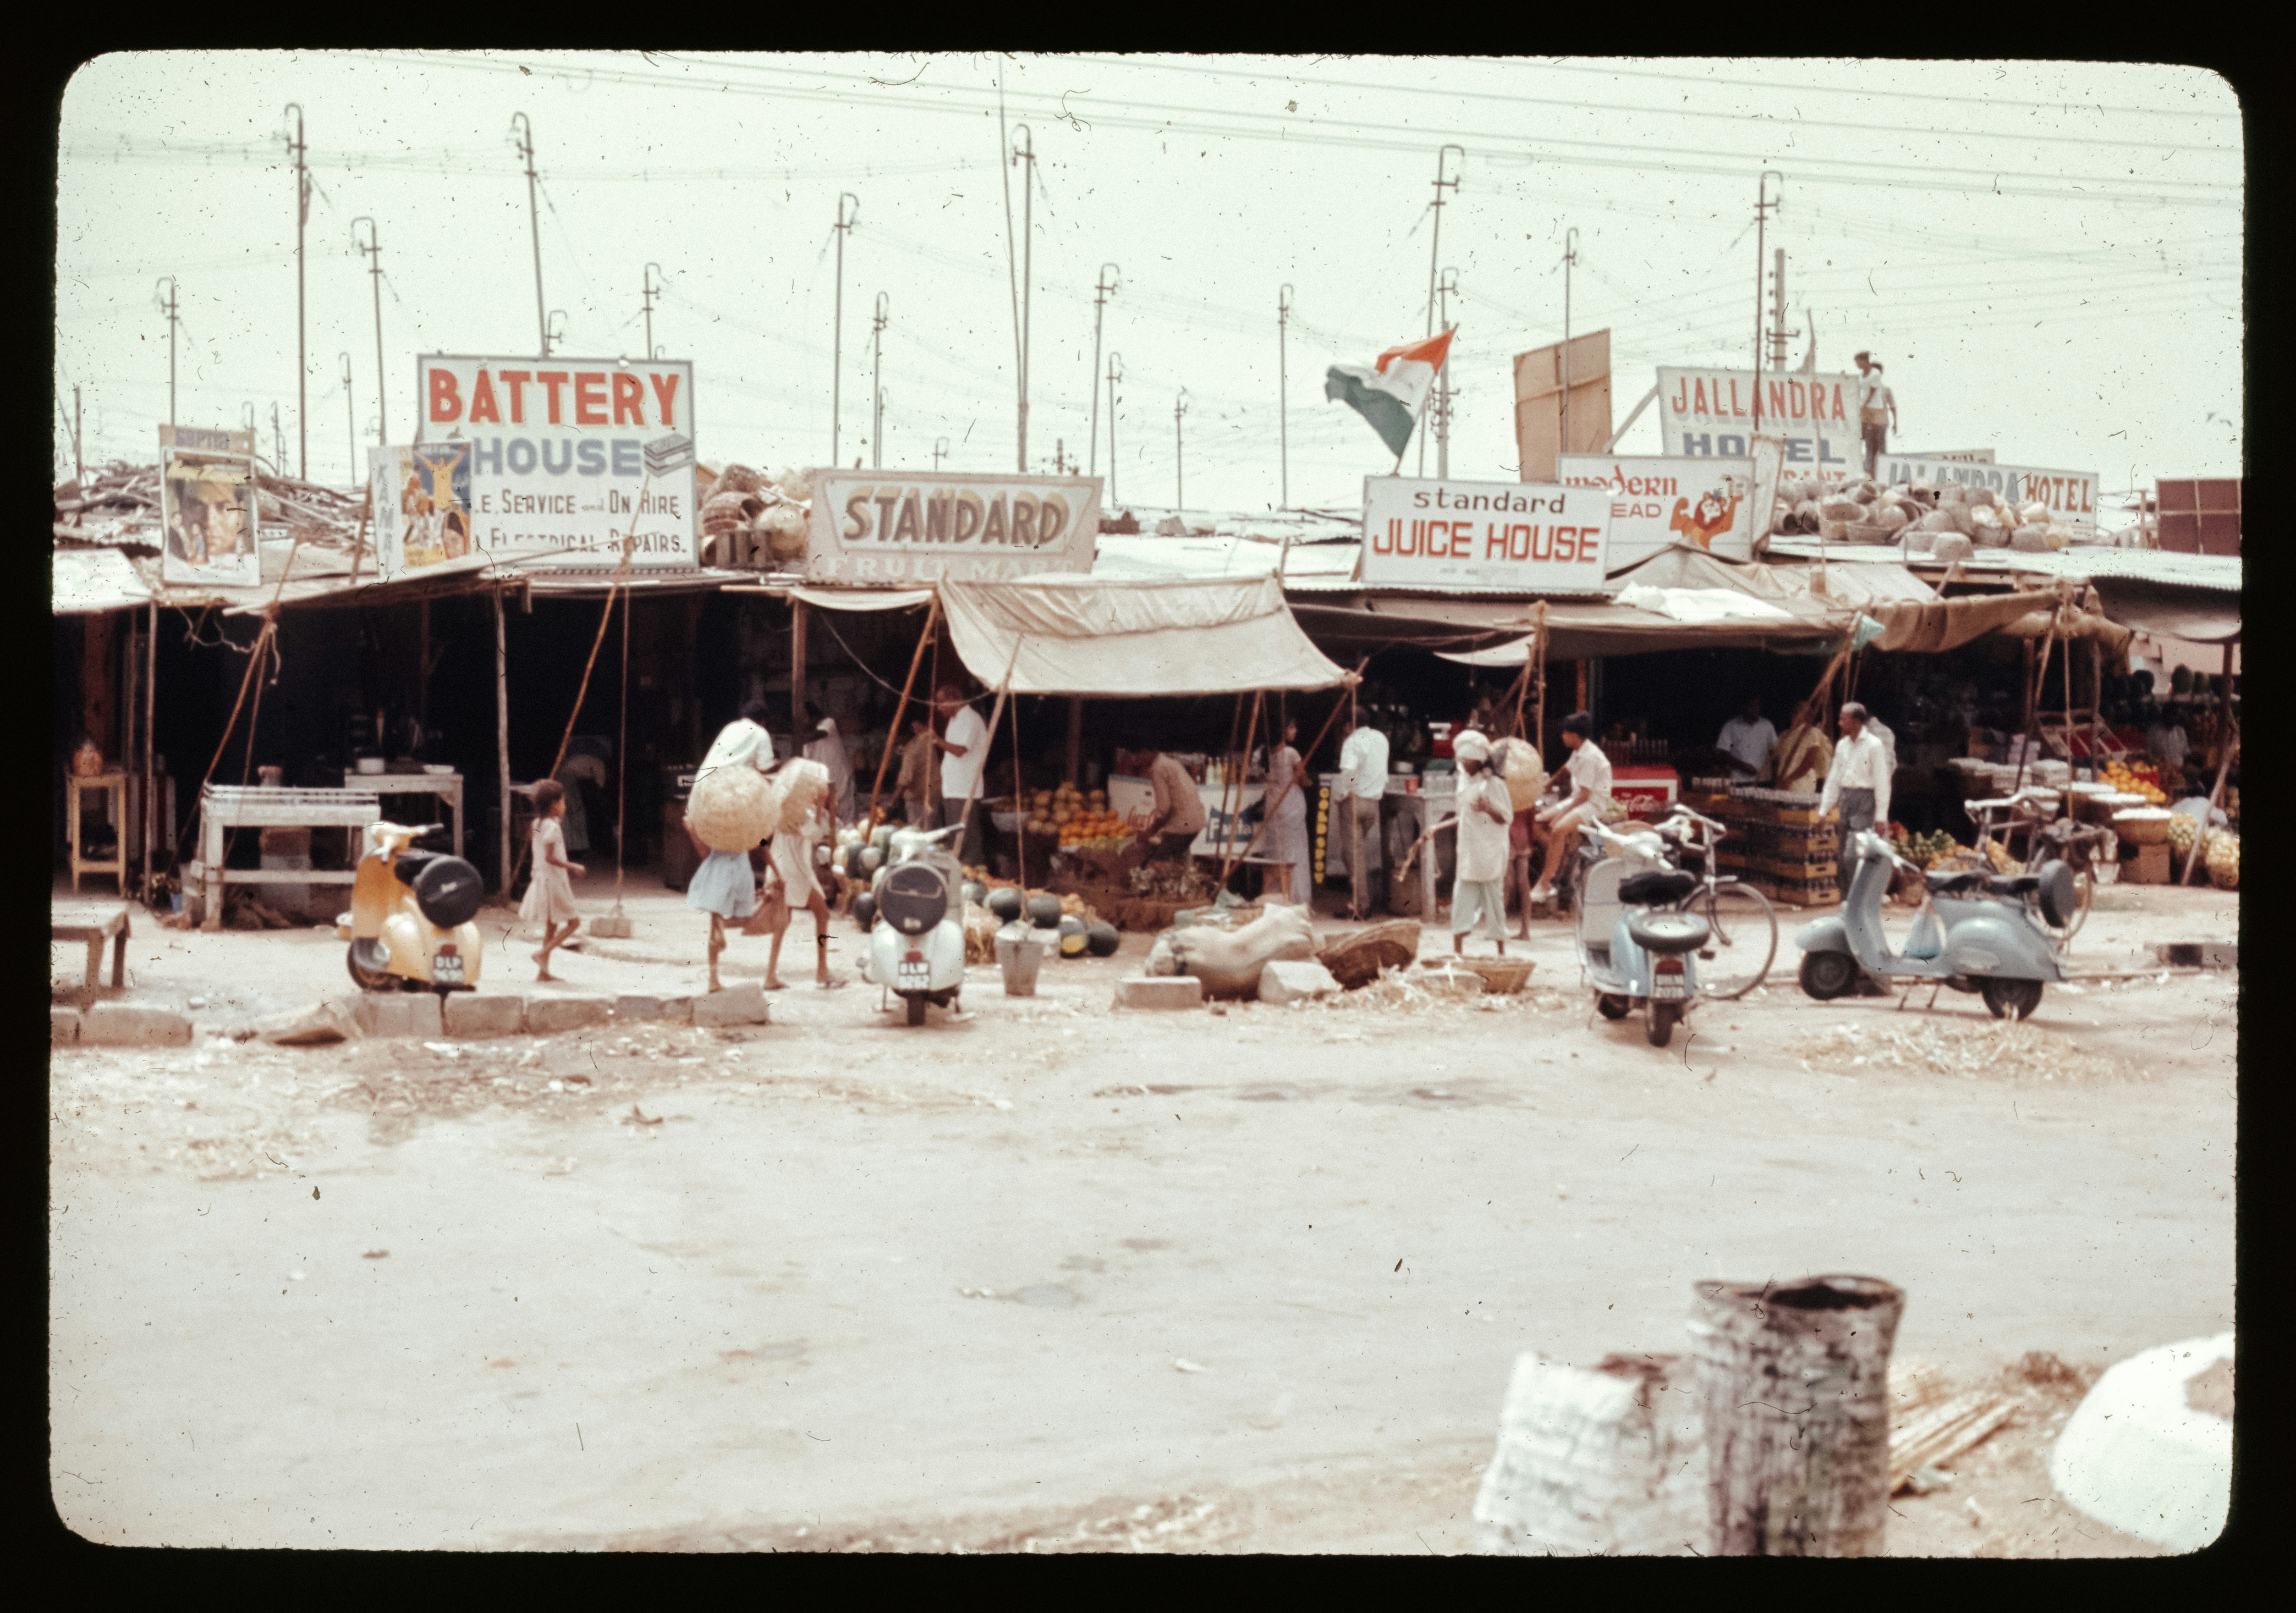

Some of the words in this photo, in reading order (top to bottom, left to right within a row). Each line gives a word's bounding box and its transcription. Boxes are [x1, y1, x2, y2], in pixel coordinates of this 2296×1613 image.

[429, 368, 680, 426] BATTERY
[1672, 376, 1846, 422] JALLANDRA
[474, 437, 642, 477] HOUSE
[1683, 432, 1846, 464] HOEL
[1414, 488, 1565, 514] standard
[1611, 503, 1662, 518] EAD
[2025, 475, 2092, 513] HOTEL
[843, 487, 1069, 545] STANDARD
[610, 528, 687, 553] RPAIRS.
[1373, 518, 1472, 558] JUICE
[1486, 523, 1600, 562] HOUSE
